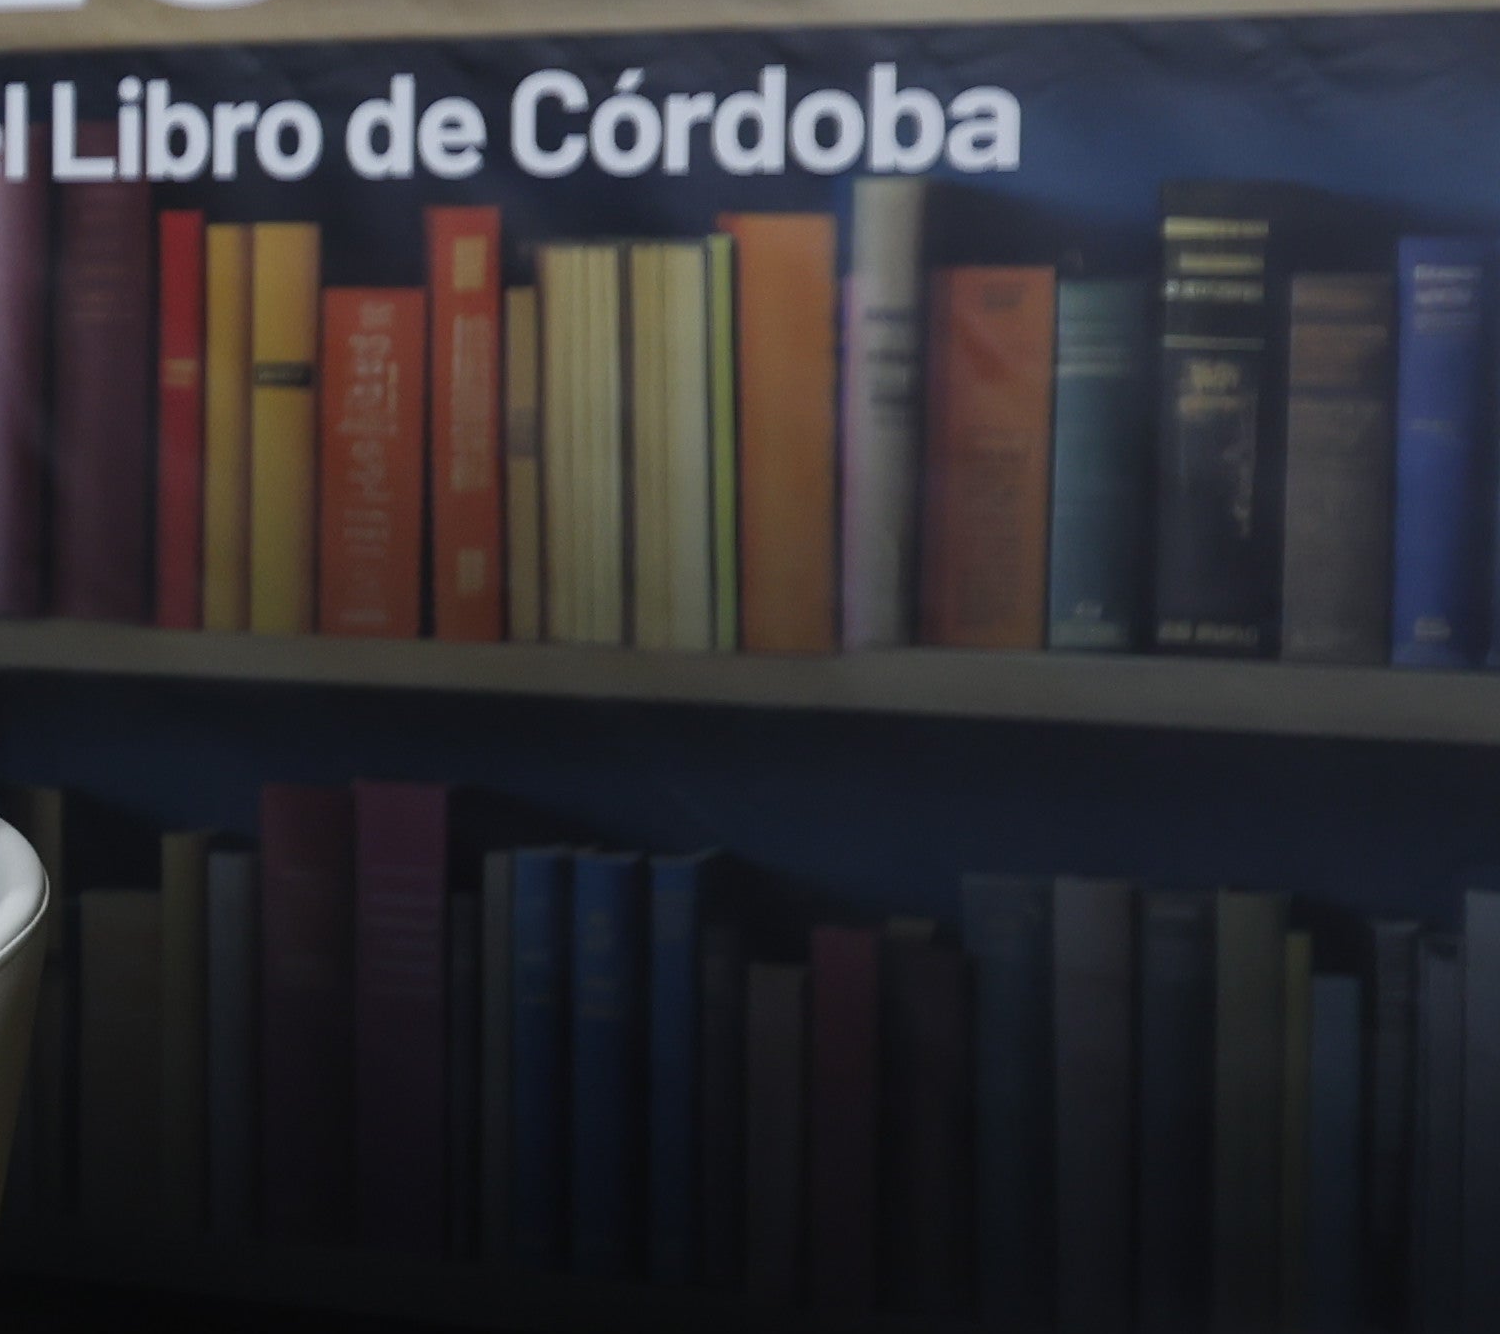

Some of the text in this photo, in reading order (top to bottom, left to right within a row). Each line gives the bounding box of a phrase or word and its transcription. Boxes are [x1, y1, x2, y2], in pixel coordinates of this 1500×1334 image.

[51, 76, 323, 183] Libro
[345, 72, 486, 180] de
[509, 62, 1022, 179] Córdoba
